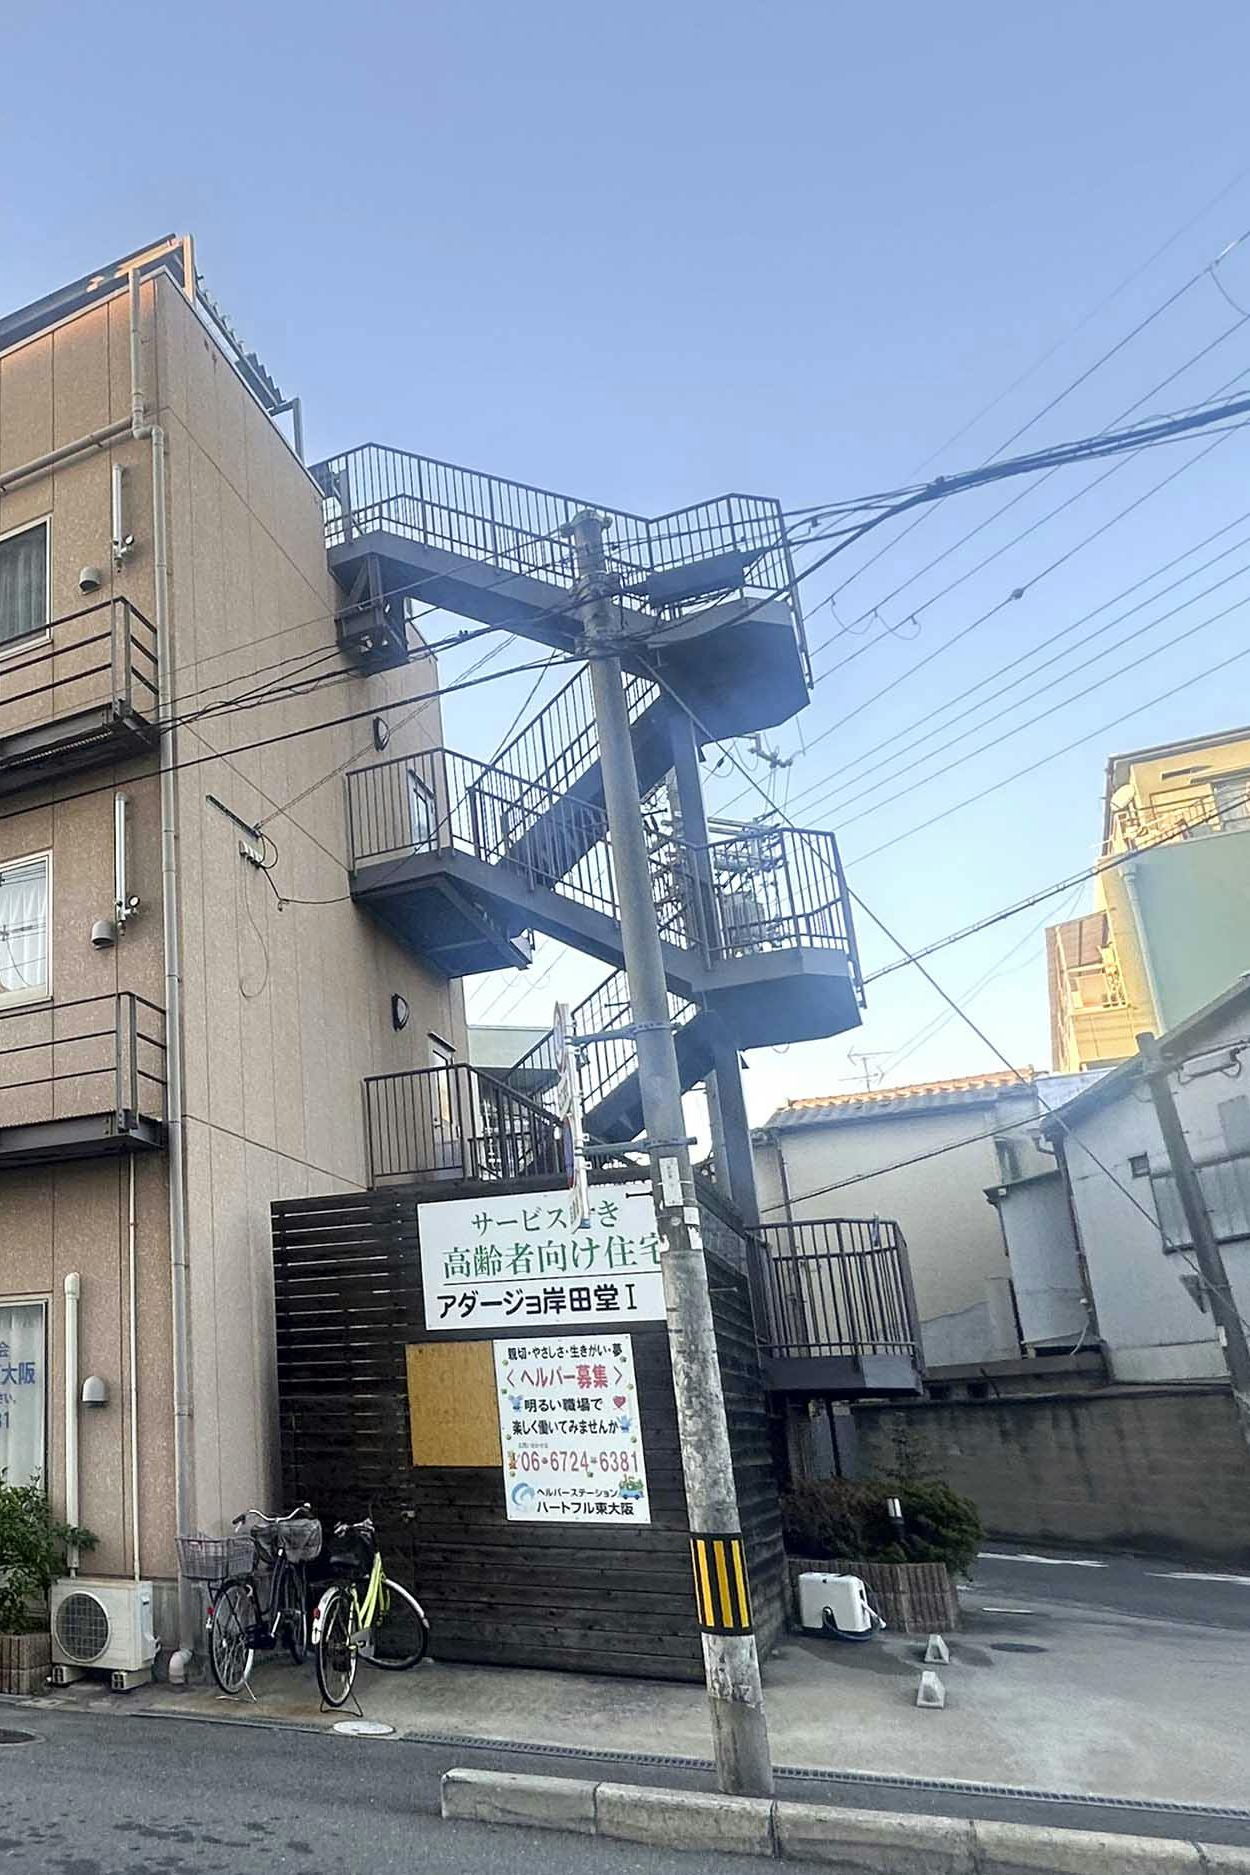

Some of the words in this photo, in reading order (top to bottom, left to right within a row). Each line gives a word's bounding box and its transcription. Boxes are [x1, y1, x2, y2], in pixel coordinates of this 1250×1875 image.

[471, 1200, 620, 1237] サービスき
[443, 1232, 661, 1279] 高齢者向け住宅
[524, 1398, 603, 1412] 明るい職場で
[512, 1419, 619, 1435] 楽しく働いてみませんか
[536, 1502, 635, 1515] ハートフル東大阪
